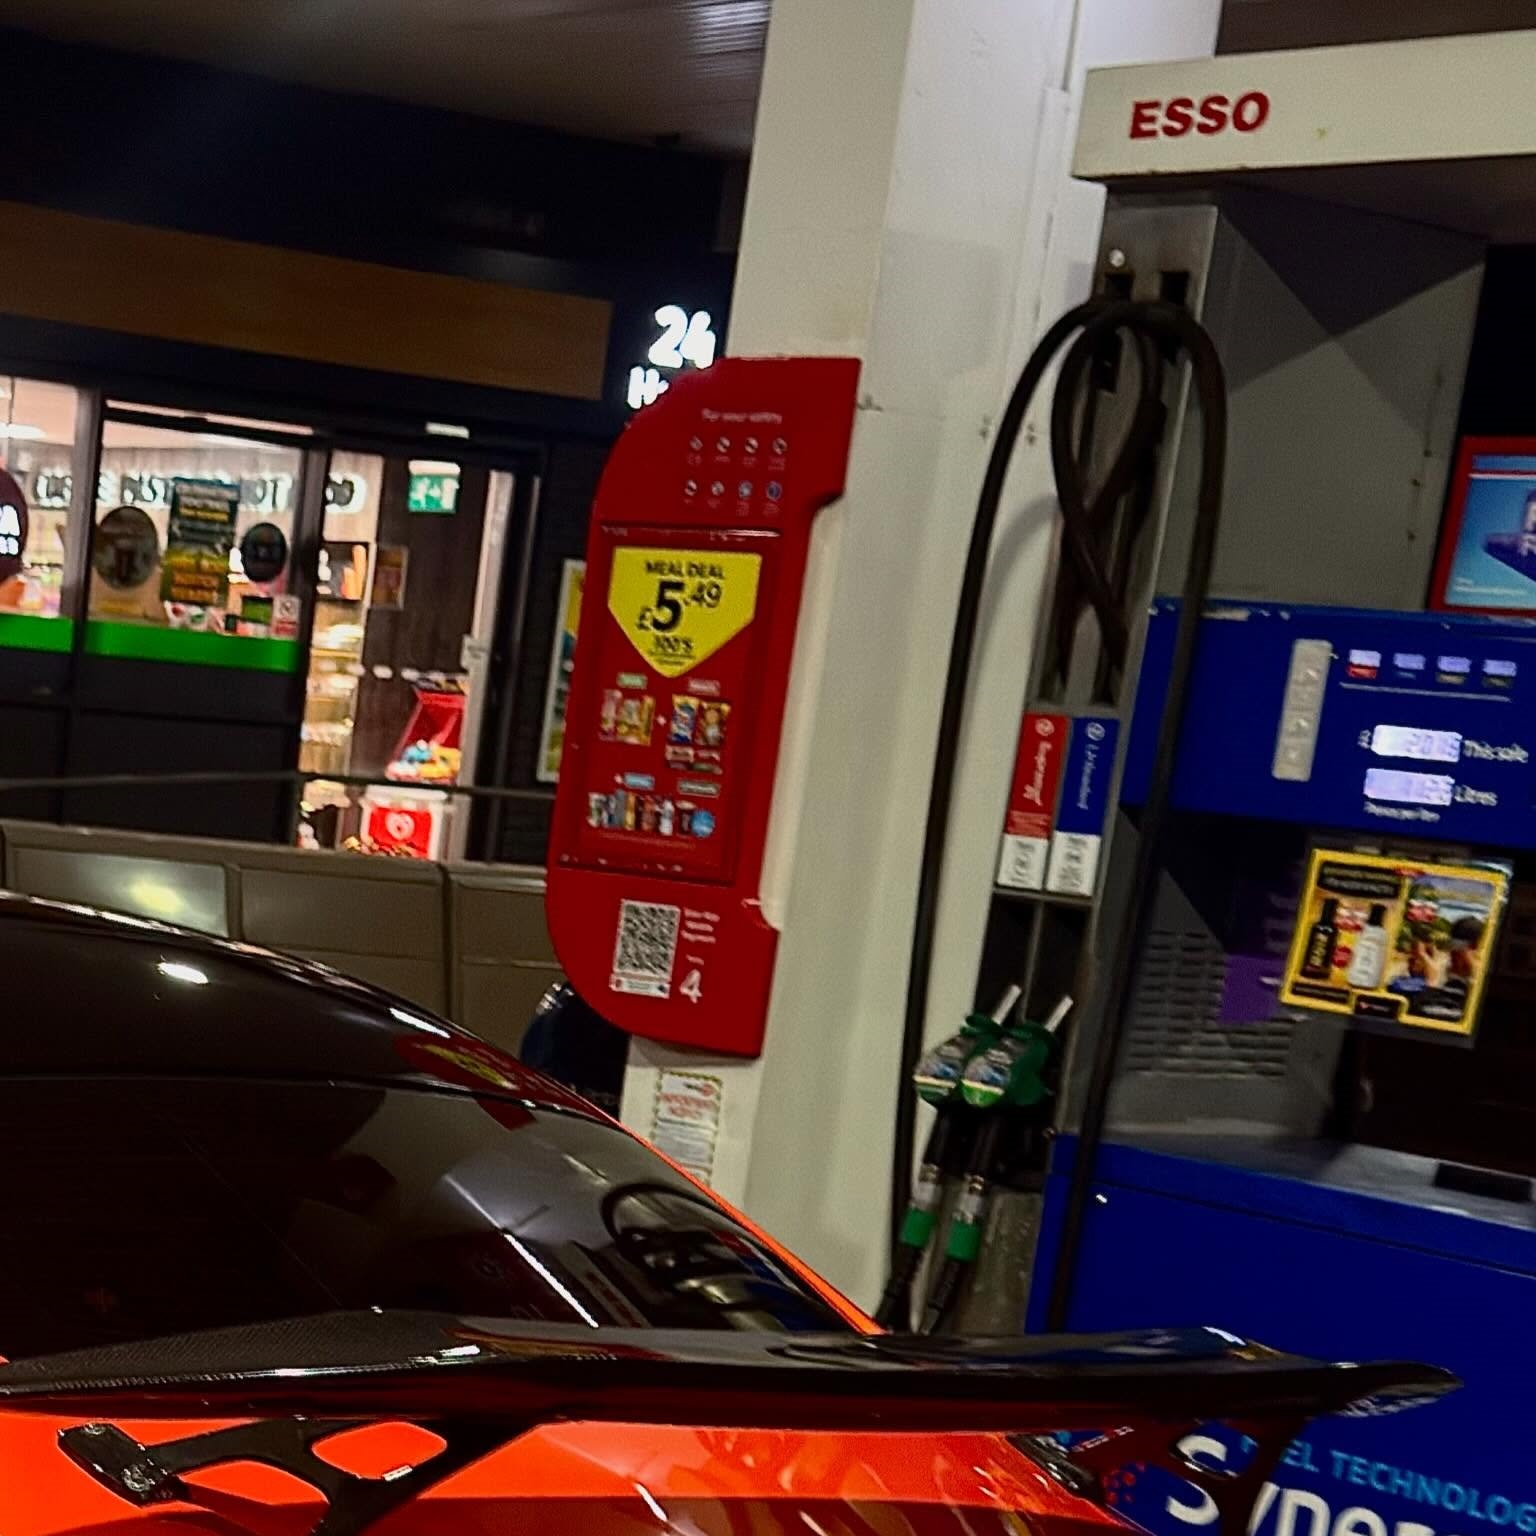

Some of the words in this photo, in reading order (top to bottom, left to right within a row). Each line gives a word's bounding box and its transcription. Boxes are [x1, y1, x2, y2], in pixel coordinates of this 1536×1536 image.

[1128, 91, 1271, 140] ESSO
[648, 304, 716, 370] 24
[627, 365, 670, 409] H
[679, 968, 703, 1004] 4
